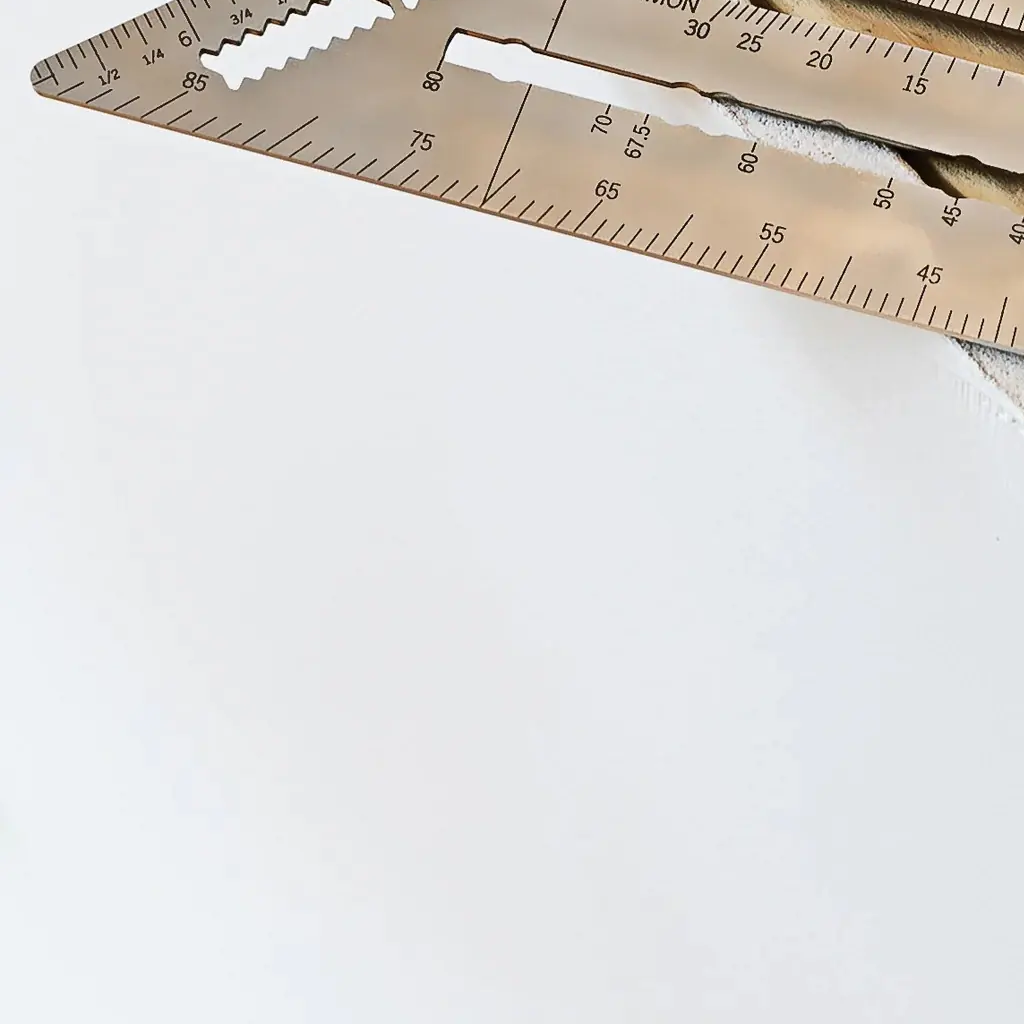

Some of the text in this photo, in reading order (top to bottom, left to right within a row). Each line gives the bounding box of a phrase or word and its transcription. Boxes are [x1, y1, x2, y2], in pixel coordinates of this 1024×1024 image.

[98, 68, 121, 86] 1/2
[141, 48, 165, 66] 1/4
[177, 30, 193, 48] 6
[229, 8, 253, 26] 3/4
[683, 18, 711, 40] 30
[735, 32, 764, 53] 25
[805, 50, 833, 70] 20
[902, 74, 929, 95] 15
[182, 71, 210, 92] 85
[410, 129, 436, 151] 75
[595, 179, 622, 200] 65
[759, 222, 787, 244] 55
[916, 264, 944, 285] 45
[422, 70, 444, 92] 80
[590, 114, 613, 134] 70
[623, 124, 651, 159] 67.5
[737, 153, 759, 174] 60
[872, 188, 895, 210] 50
[941, 205, 962, 227] 45
